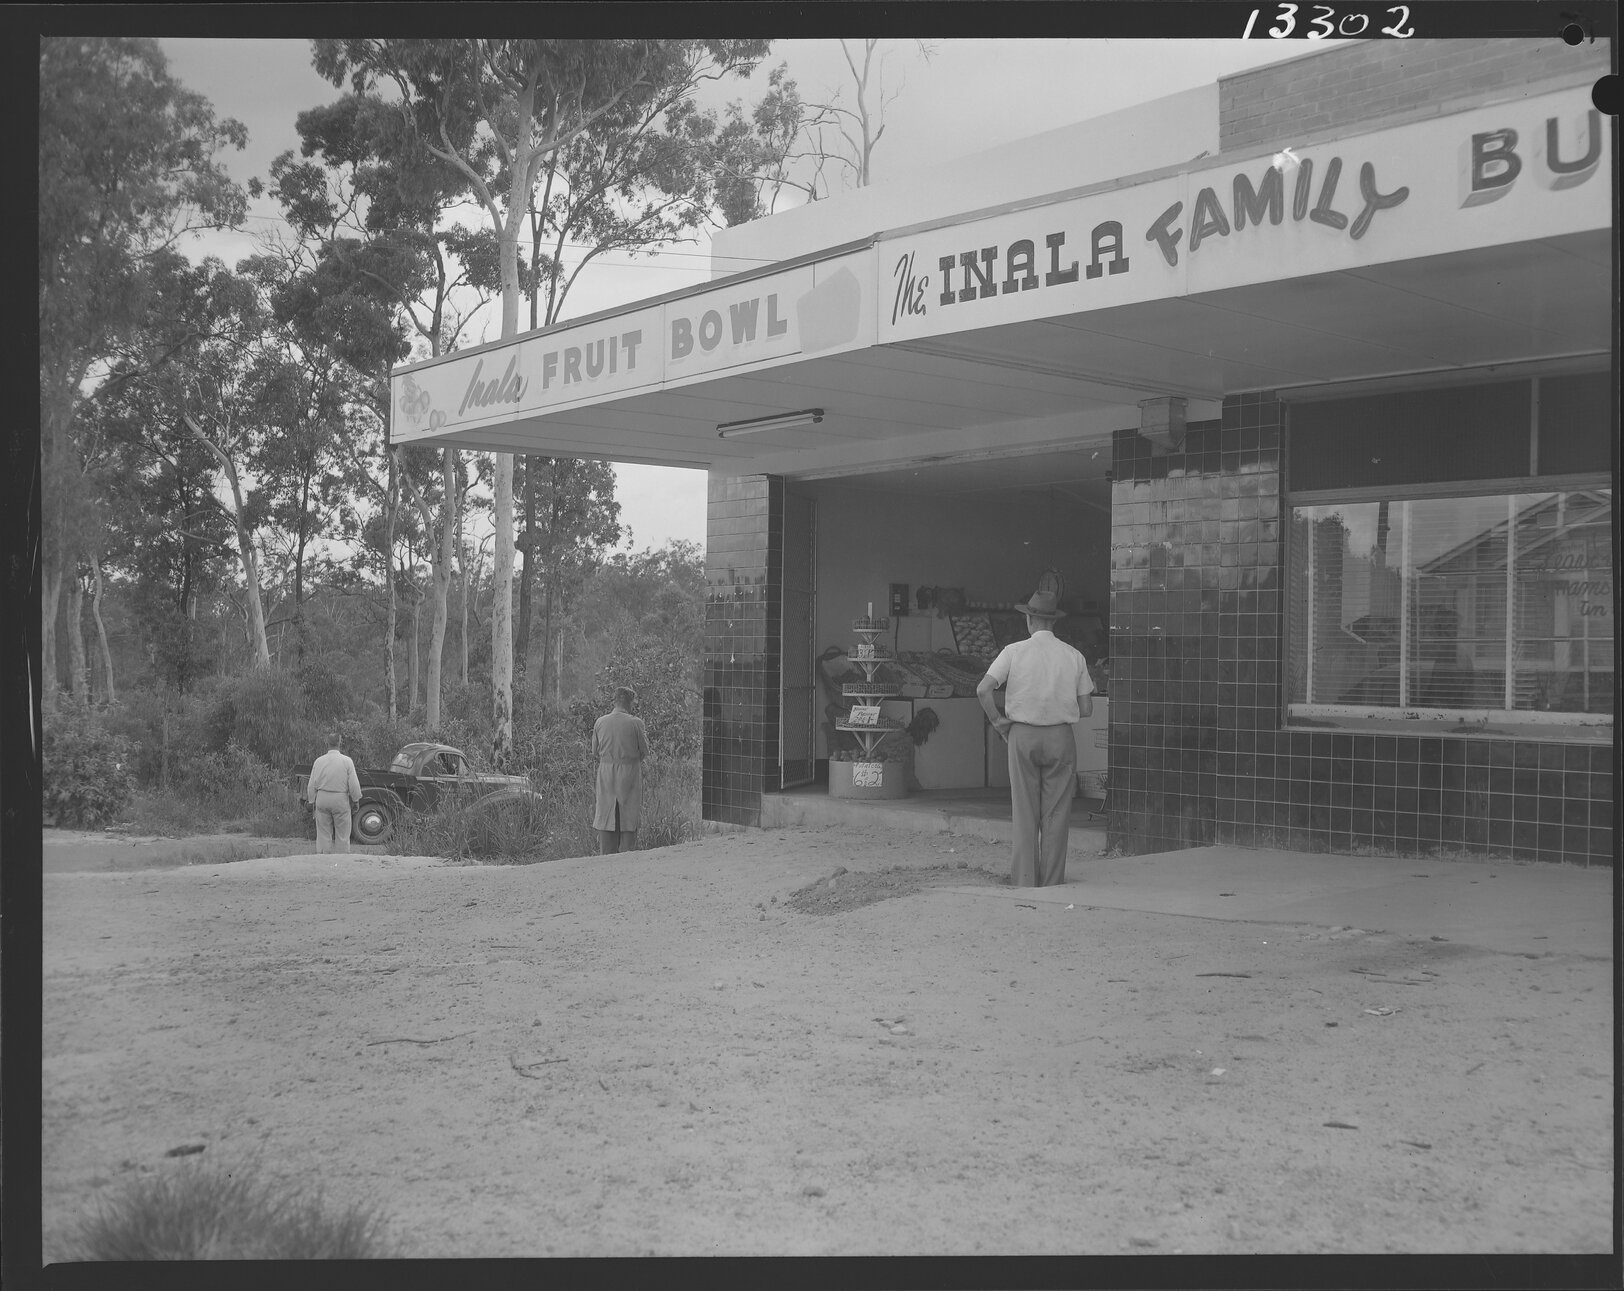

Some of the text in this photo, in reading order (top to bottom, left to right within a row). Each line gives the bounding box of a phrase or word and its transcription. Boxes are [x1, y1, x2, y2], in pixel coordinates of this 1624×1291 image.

[892, 109, 1602, 325] The INALA FAMILY BU
[458, 292, 789, 417] Inala FRUIT BOWL
